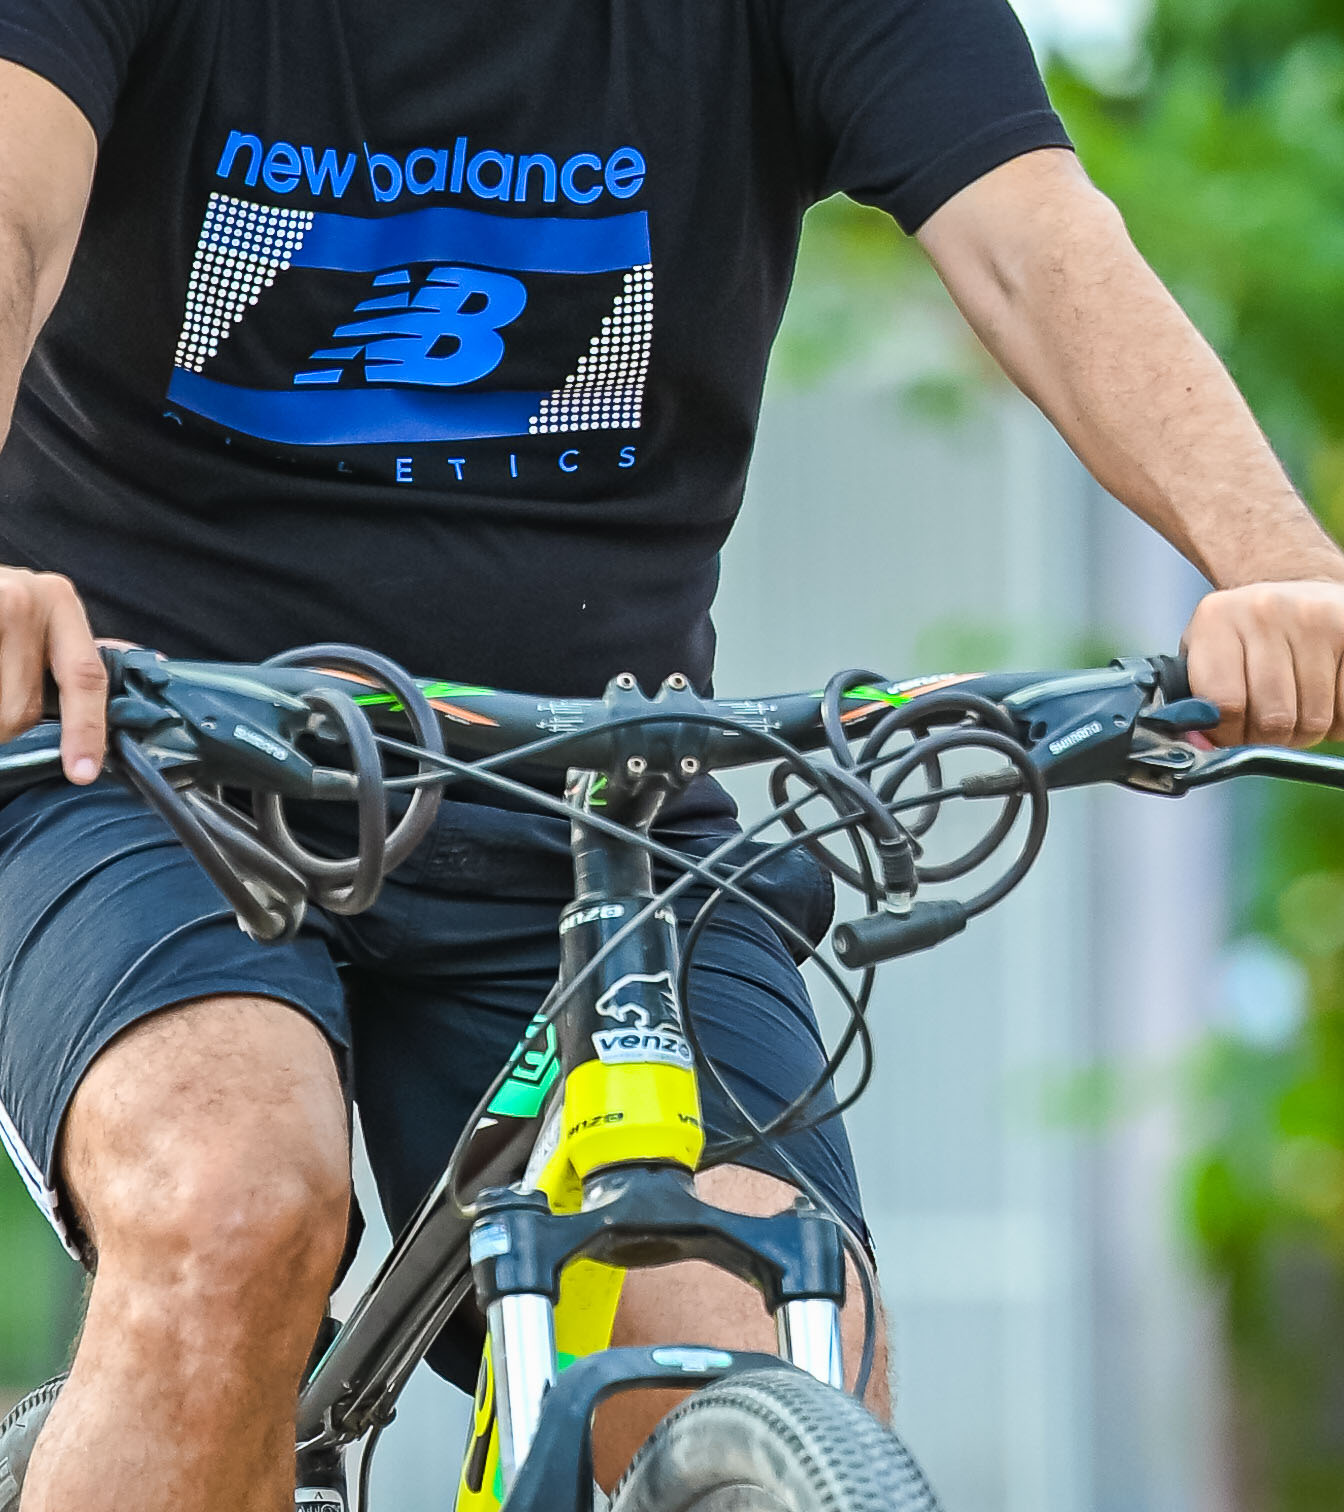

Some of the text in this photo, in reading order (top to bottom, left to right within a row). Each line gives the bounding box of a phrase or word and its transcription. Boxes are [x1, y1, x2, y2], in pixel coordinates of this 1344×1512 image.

[216, 130, 646, 204] new balance
[600, 1035, 692, 1061] venzo
